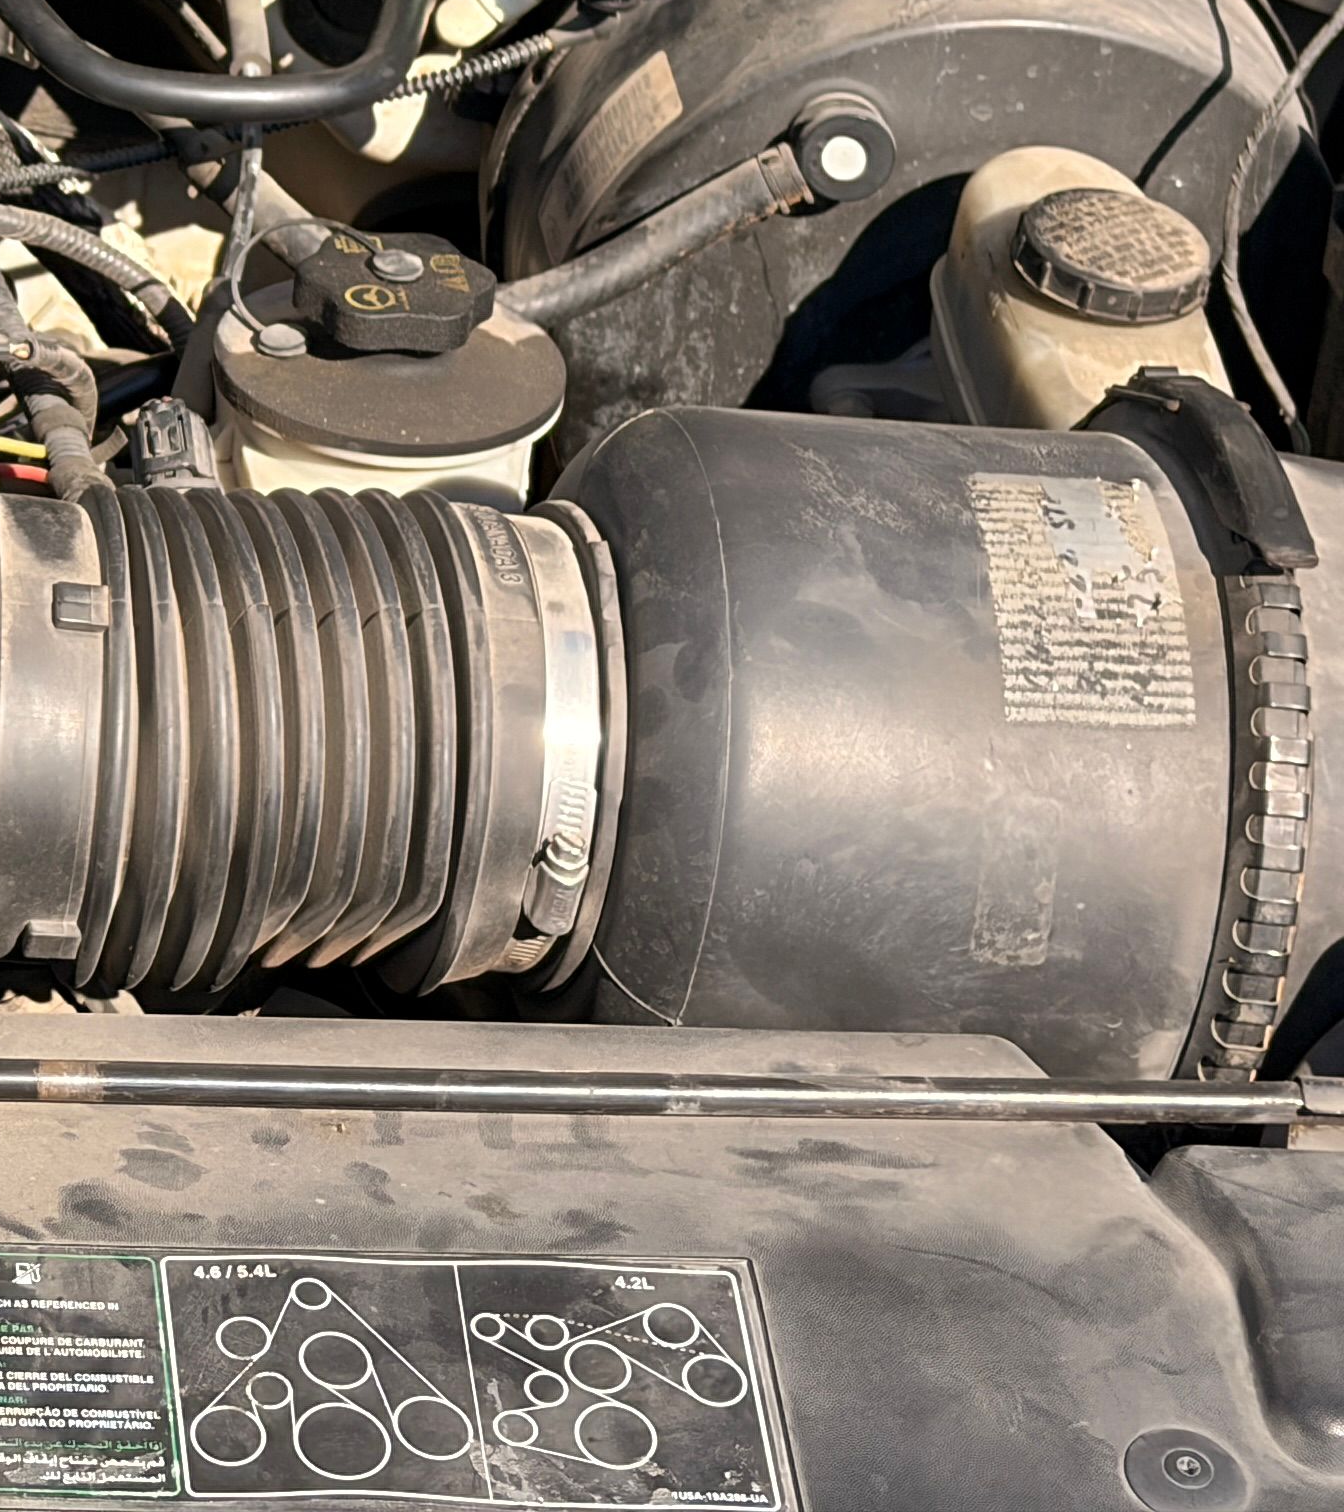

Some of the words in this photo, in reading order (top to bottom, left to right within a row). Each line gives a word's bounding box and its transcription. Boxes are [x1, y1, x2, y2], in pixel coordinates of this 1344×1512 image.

[194, 1265, 223, 1279] 4.6
[237, 1266, 277, 1280] 5.4L
[614, 1275, 655, 1291] 4.2L
[13, 1299, 29, 1308] AS
[31, 1300, 105, 1310] REFERENCED
[0, 1336, 54, 1346] COUPURE
[57, 1337, 73, 1347] DE
[6, 1371, 48, 1381] CIERRE
[50, 1372, 72, 1382] DEL
[74, 1373, 154, 1384] COMBUSTIBLE
